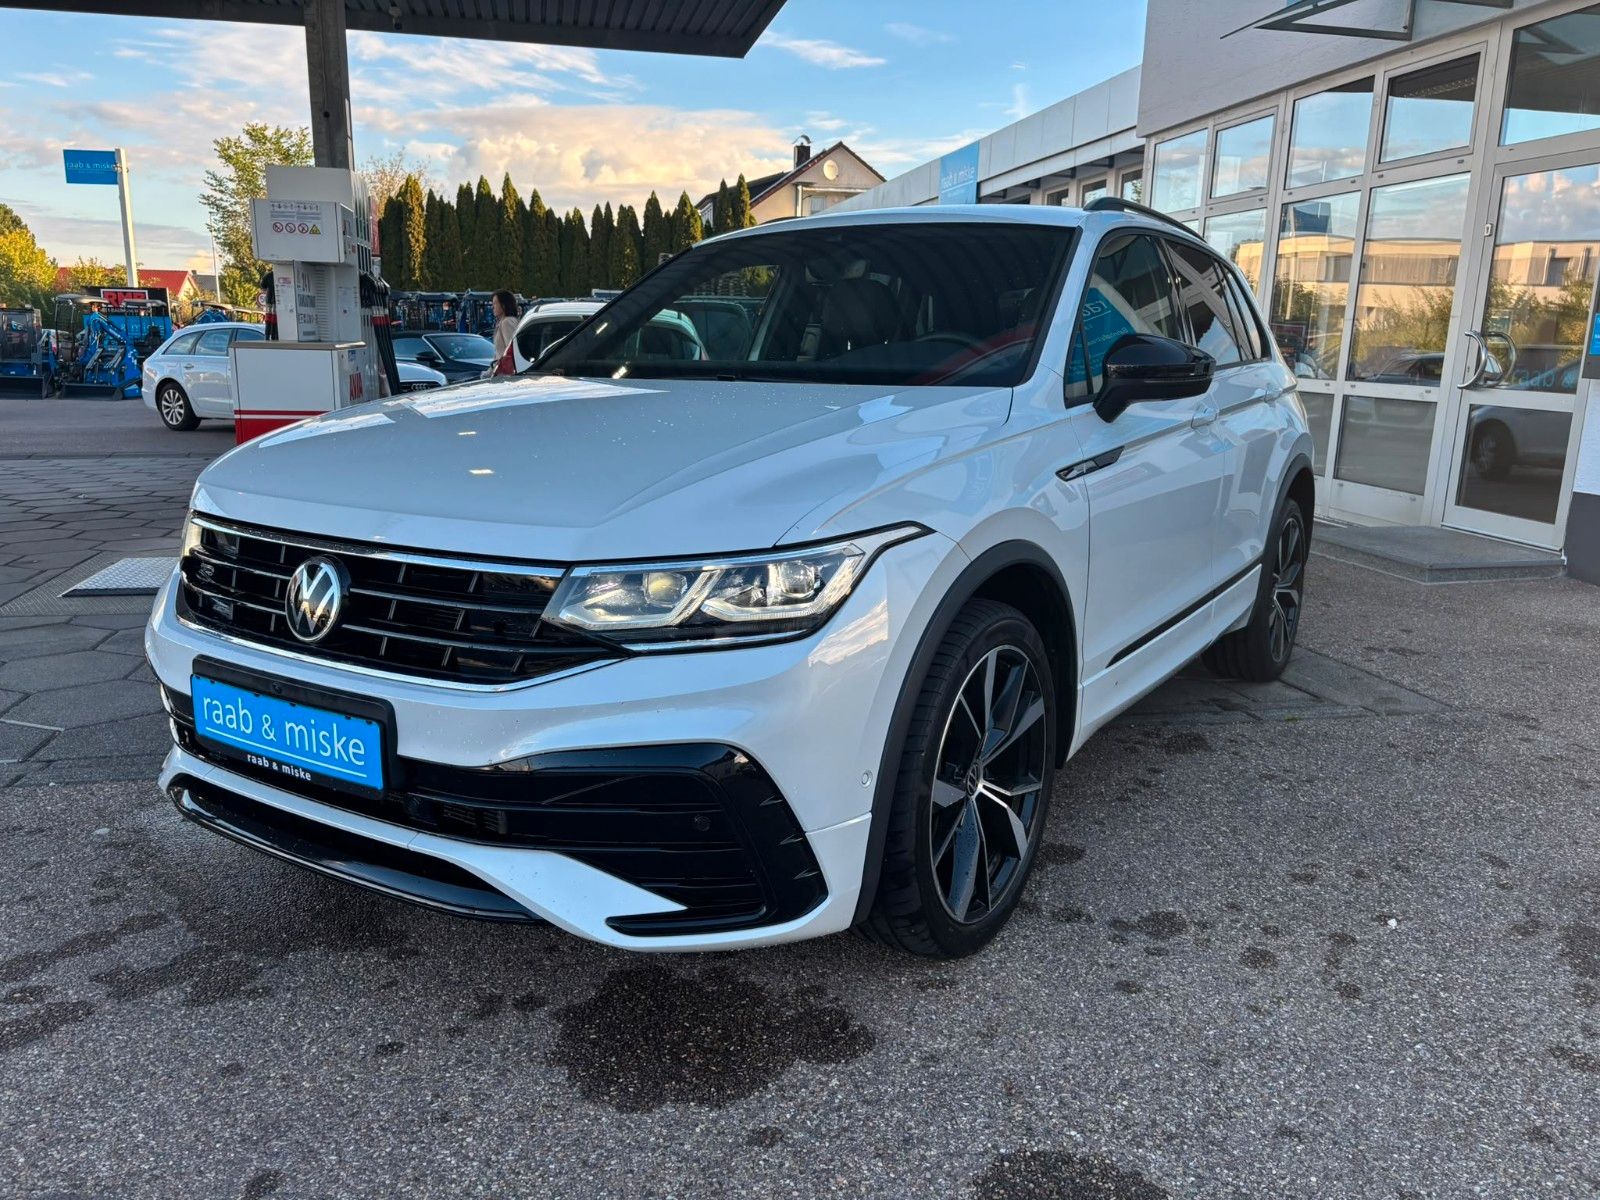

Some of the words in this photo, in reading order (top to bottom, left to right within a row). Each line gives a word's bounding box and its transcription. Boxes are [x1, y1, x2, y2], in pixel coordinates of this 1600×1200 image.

[203, 697, 254, 735] raab
[262, 714, 277, 742] &
[285, 719, 366, 766] miske
[247, 753, 270, 767] raab
[272, 761, 279, 771] &
[281, 764, 312, 781] miske
